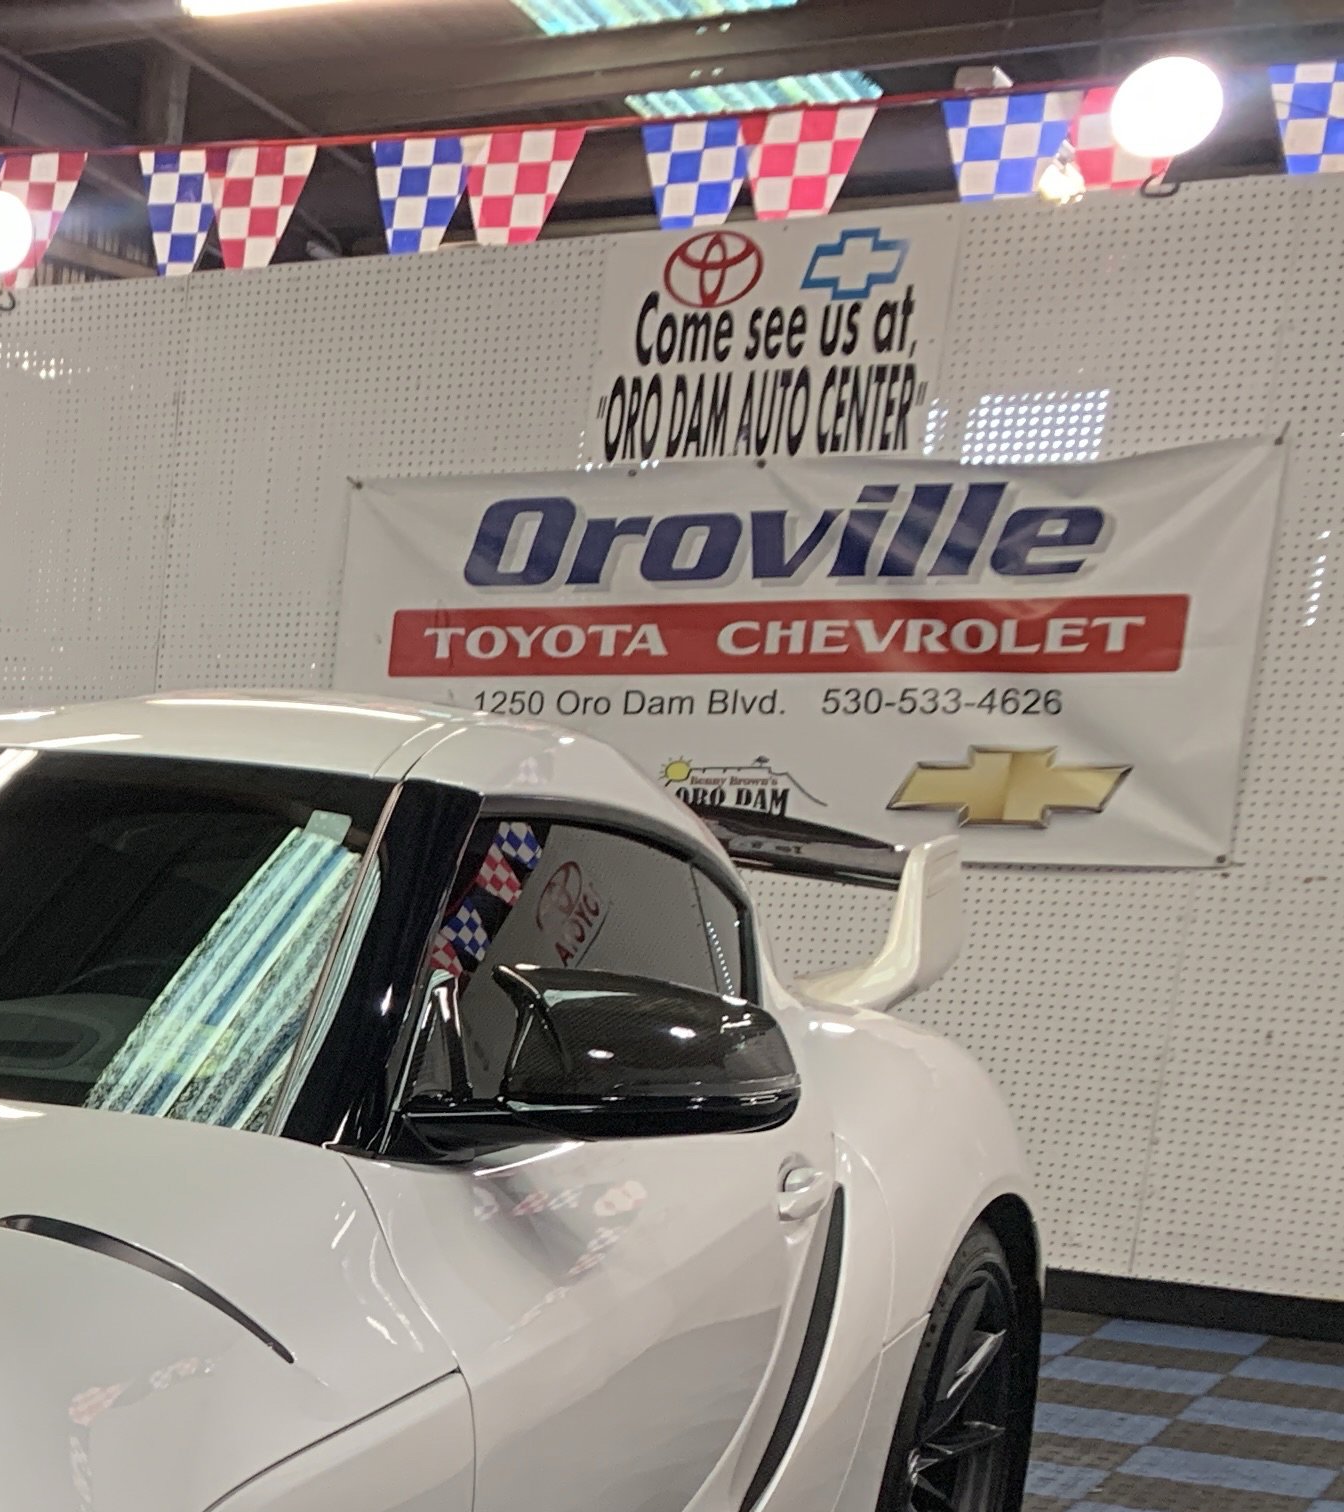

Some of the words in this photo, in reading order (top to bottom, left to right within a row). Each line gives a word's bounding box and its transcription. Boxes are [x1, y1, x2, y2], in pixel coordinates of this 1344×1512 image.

[635, 290, 734, 366] Come
[744, 304, 807, 361] see
[819, 301, 861, 356] us
[873, 284, 917, 358] at,
[596, 372, 662, 463] "ORO
[665, 371, 733, 458] DAM
[734, 365, 810, 457] AUTO
[817, 363, 928, 455] CENTER"
[462, 481, 1108, 589] Oroville
[424, 624, 669, 661] TOYOTA
[717, 615, 1147, 659] CHEVROLET
[473, 689, 544, 718] 1250
[556, 689, 611, 716] Oro
[624, 689, 694, 716] Dam
[708, 689, 786, 716] Blvd.
[822, 688, 1064, 717] 530-533-4626
[729, 775, 778, 786] Brown's
[735, 788, 789, 816] DAM
